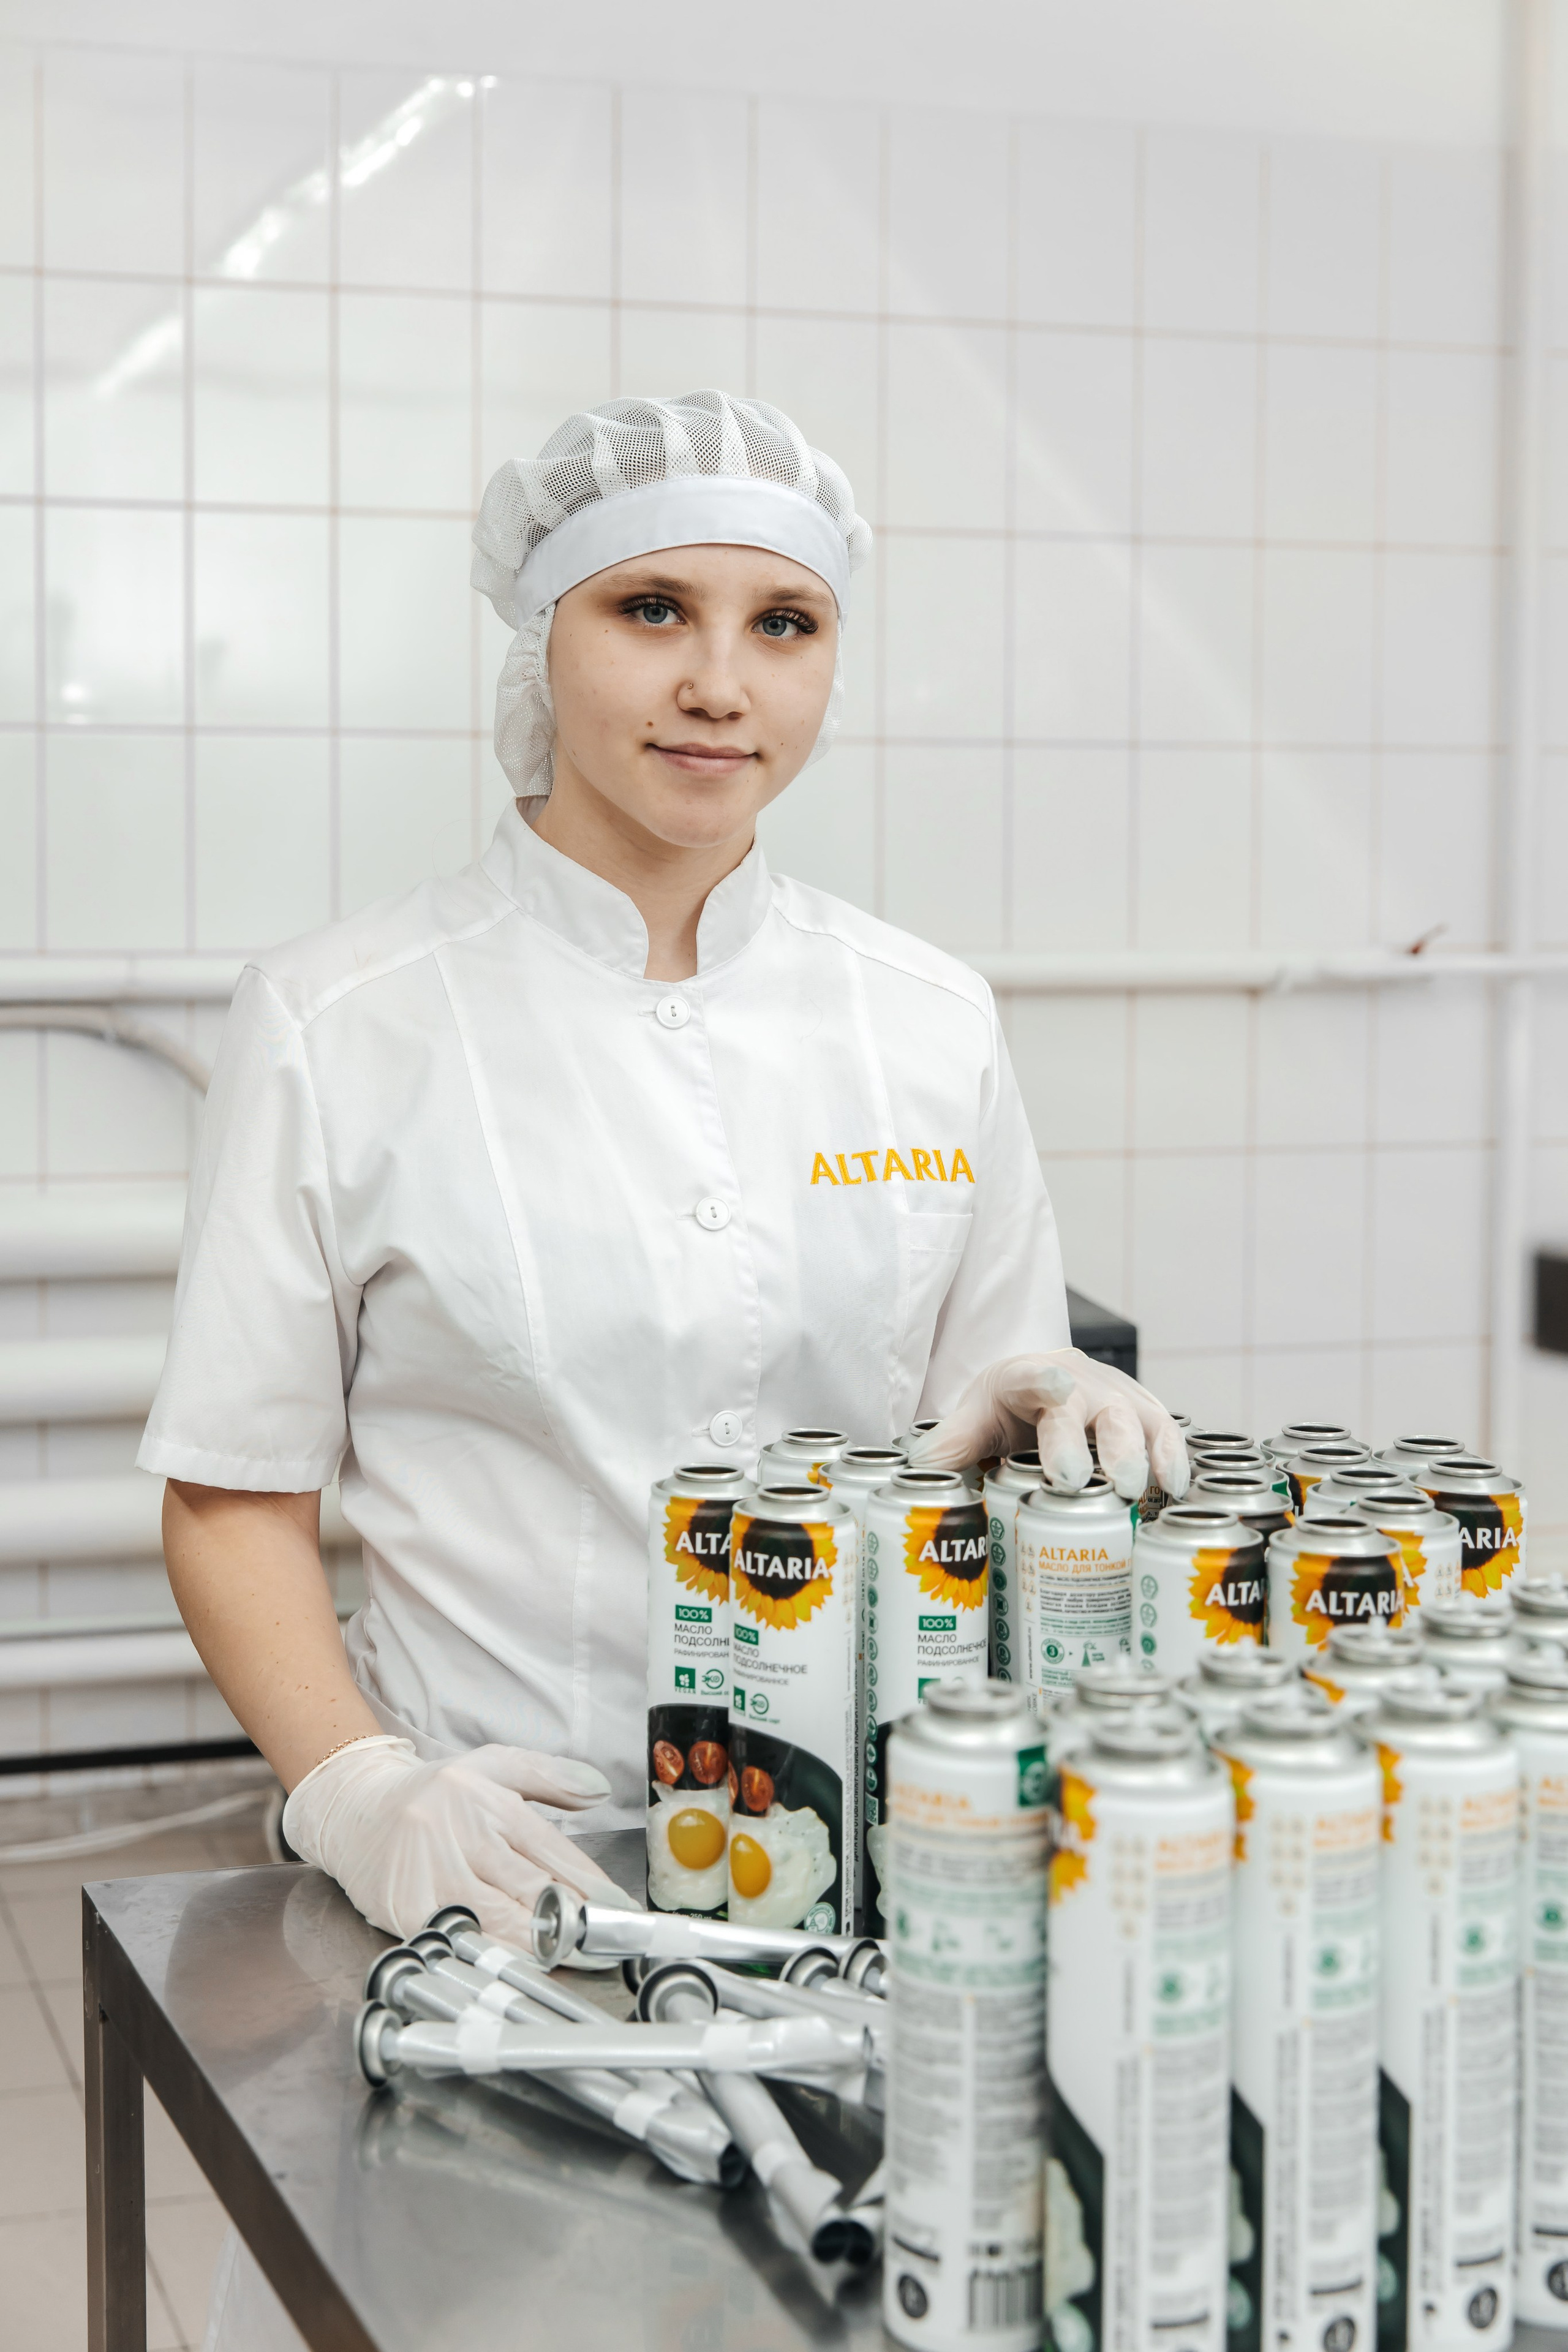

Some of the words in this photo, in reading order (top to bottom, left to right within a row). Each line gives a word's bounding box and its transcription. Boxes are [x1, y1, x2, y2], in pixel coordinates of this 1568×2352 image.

[810, 1148, 975, 1185] ALTARIA
[1459, 1526, 1517, 1549] ARIA
[1039, 1547, 1109, 1561] ALTARIA
[734, 1548, 829, 1580] ALTARIA
[1039, 1561, 1069, 1572] МАСЛО
[1072, 1564, 1091, 1575] ДЛЯ
[679, 1608, 709, 1620] 100%
[674, 1623, 712, 1635] МАСЛО
[922, 1618, 954, 1629] 100%
[918, 1634, 957, 1643] МАСЛО
